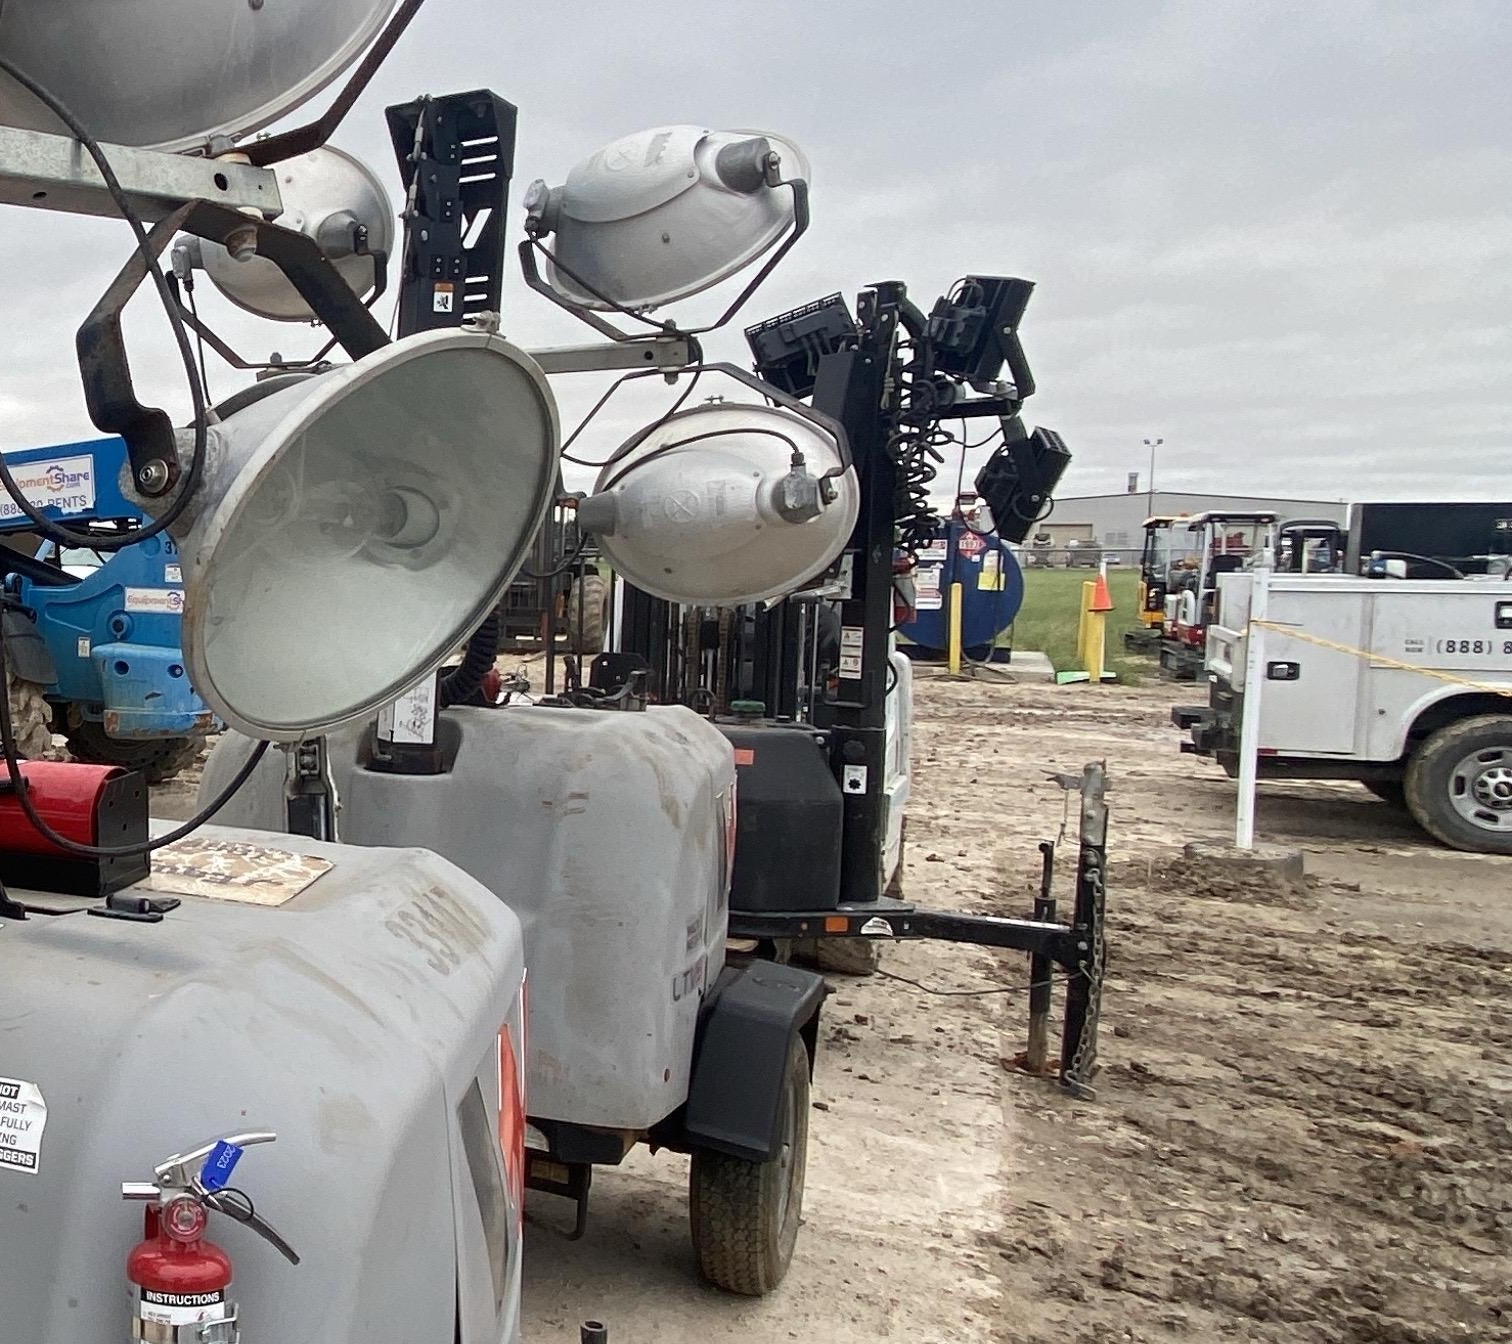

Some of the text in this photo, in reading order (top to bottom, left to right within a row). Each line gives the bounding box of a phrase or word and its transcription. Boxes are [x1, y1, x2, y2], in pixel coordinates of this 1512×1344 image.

[1436, 639, 1493, 655] (888)
[0, 1116, 33, 1131] FULLY
[216, 1145, 236, 1169] 2023
[146, 1291, 220, 1305] INSTRUCTIONS
